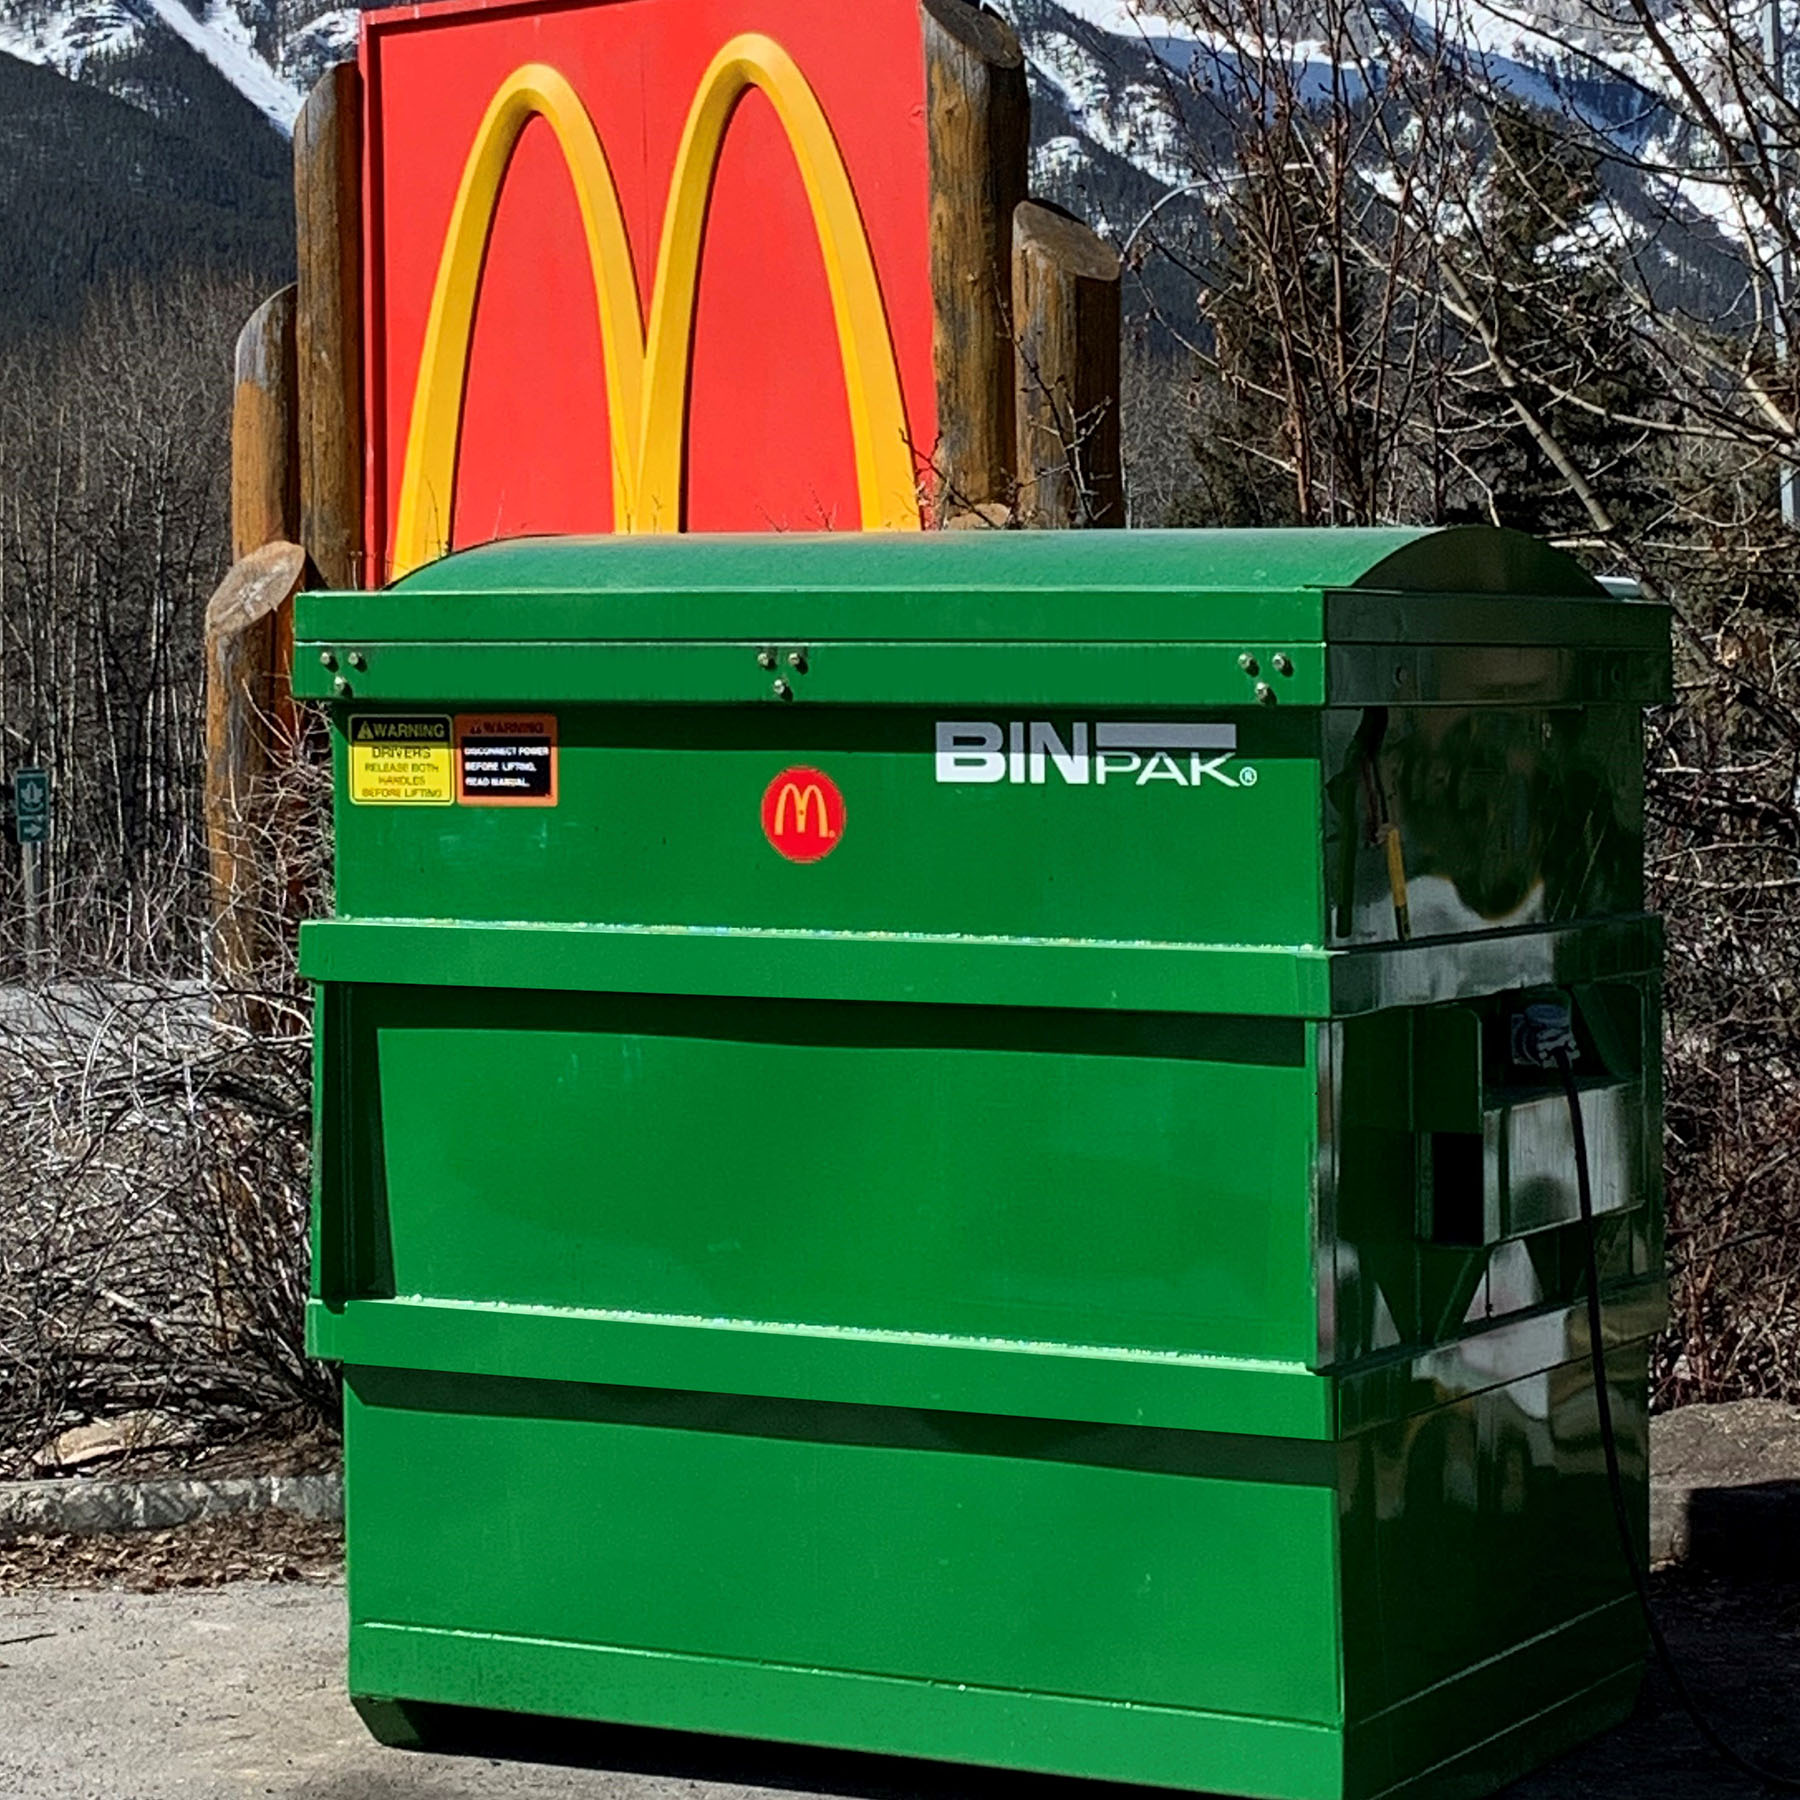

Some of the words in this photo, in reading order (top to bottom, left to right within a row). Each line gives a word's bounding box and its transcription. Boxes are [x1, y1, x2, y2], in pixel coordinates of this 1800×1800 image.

[373, 723, 445, 738] WARNING
[484, 722, 544, 734] WARNING
[372, 746, 431, 758] DRIVERS
[518, 747, 549, 756] POWER
[935, 722, 1088, 784] BIN
[1095, 751, 1241, 787] PAK
[365, 763, 408, 773] RELEASE
[411, 763, 439, 773] BOTH
[465, 762, 499, 771] BEFORE
[378, 776, 426, 786] HANDLES
[465, 777, 490, 786] READ
[362, 788, 401, 798] BEFORE
[404, 788, 442, 798] LIFTING
